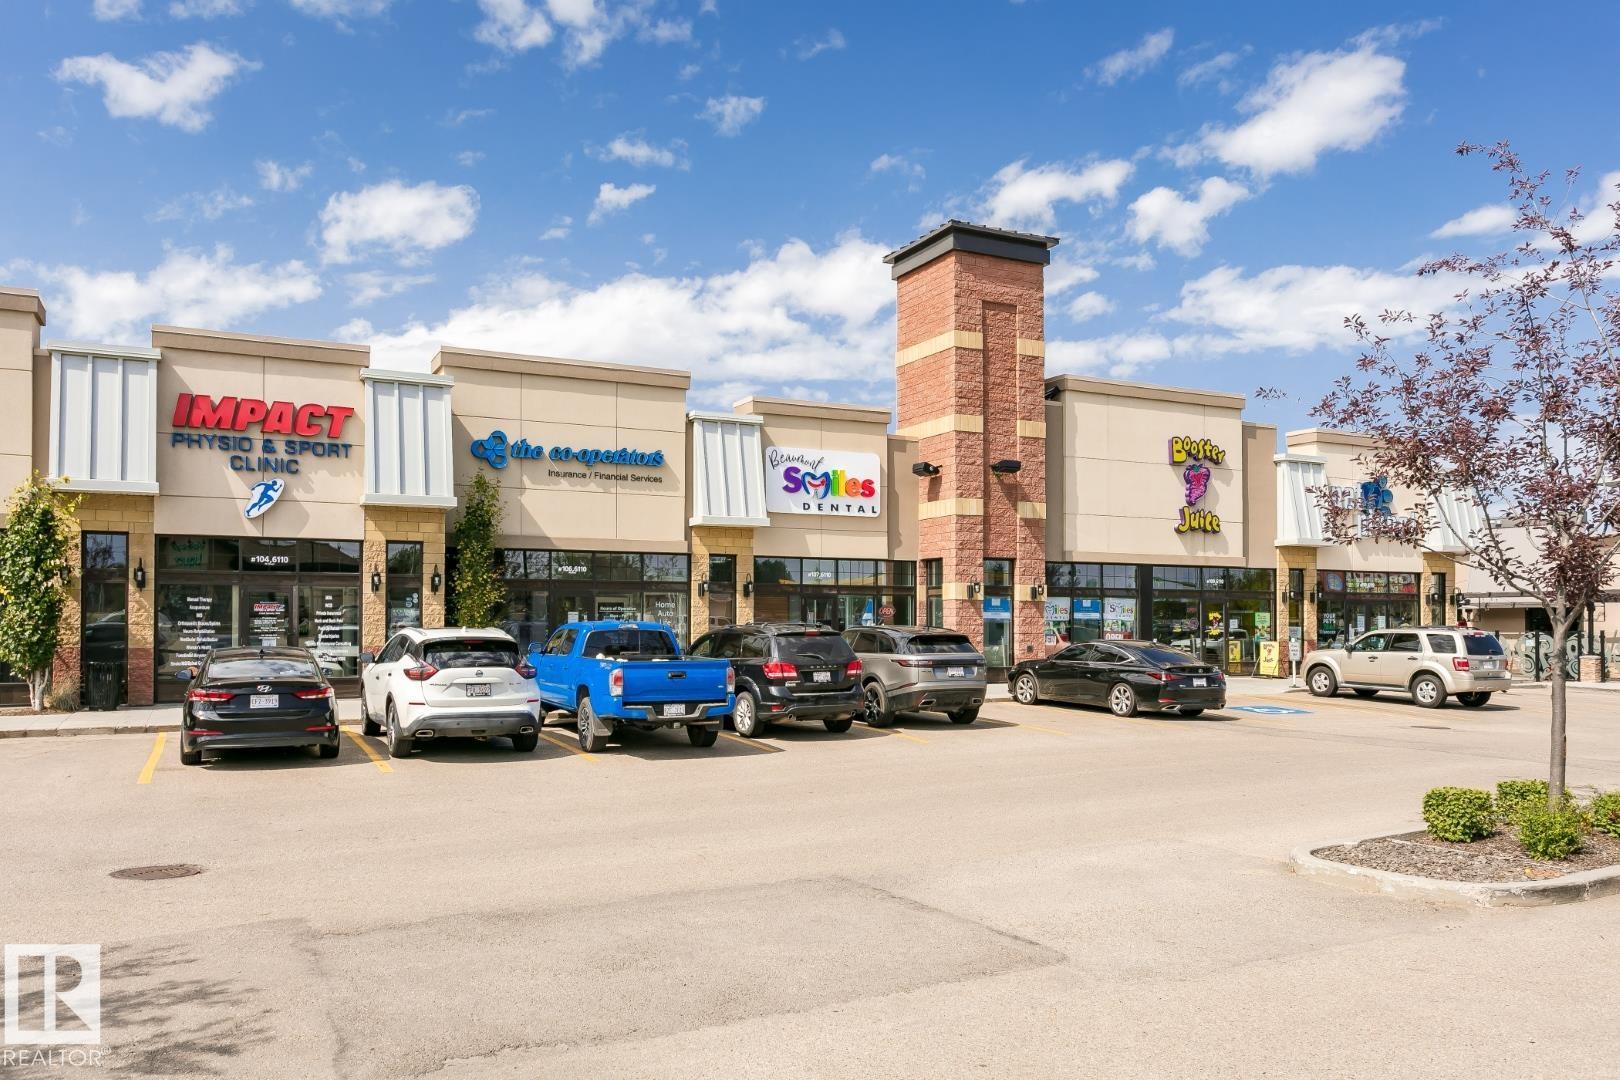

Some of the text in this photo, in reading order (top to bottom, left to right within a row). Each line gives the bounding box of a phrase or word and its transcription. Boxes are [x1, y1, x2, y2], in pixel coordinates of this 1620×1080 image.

[172, 392, 355, 438] IMPACT
[171, 432, 353, 459] PHYSIO & SPORT
[511, 438, 666, 467] the co-operators
[1168, 436, 1226, 465] Booster
[230, 455, 300, 474] CLINIC
[768, 449, 825, 472] Beaumont
[548, 469, 588, 479] Insurance
[594, 471, 629, 481] Financial
[630, 474, 663, 483] Services
[782, 466, 876, 499] Smiles
[802, 503, 878, 514] DENTAL
[1174, 506, 1221, 534] Juice
[656, 601, 676, 609] Home
